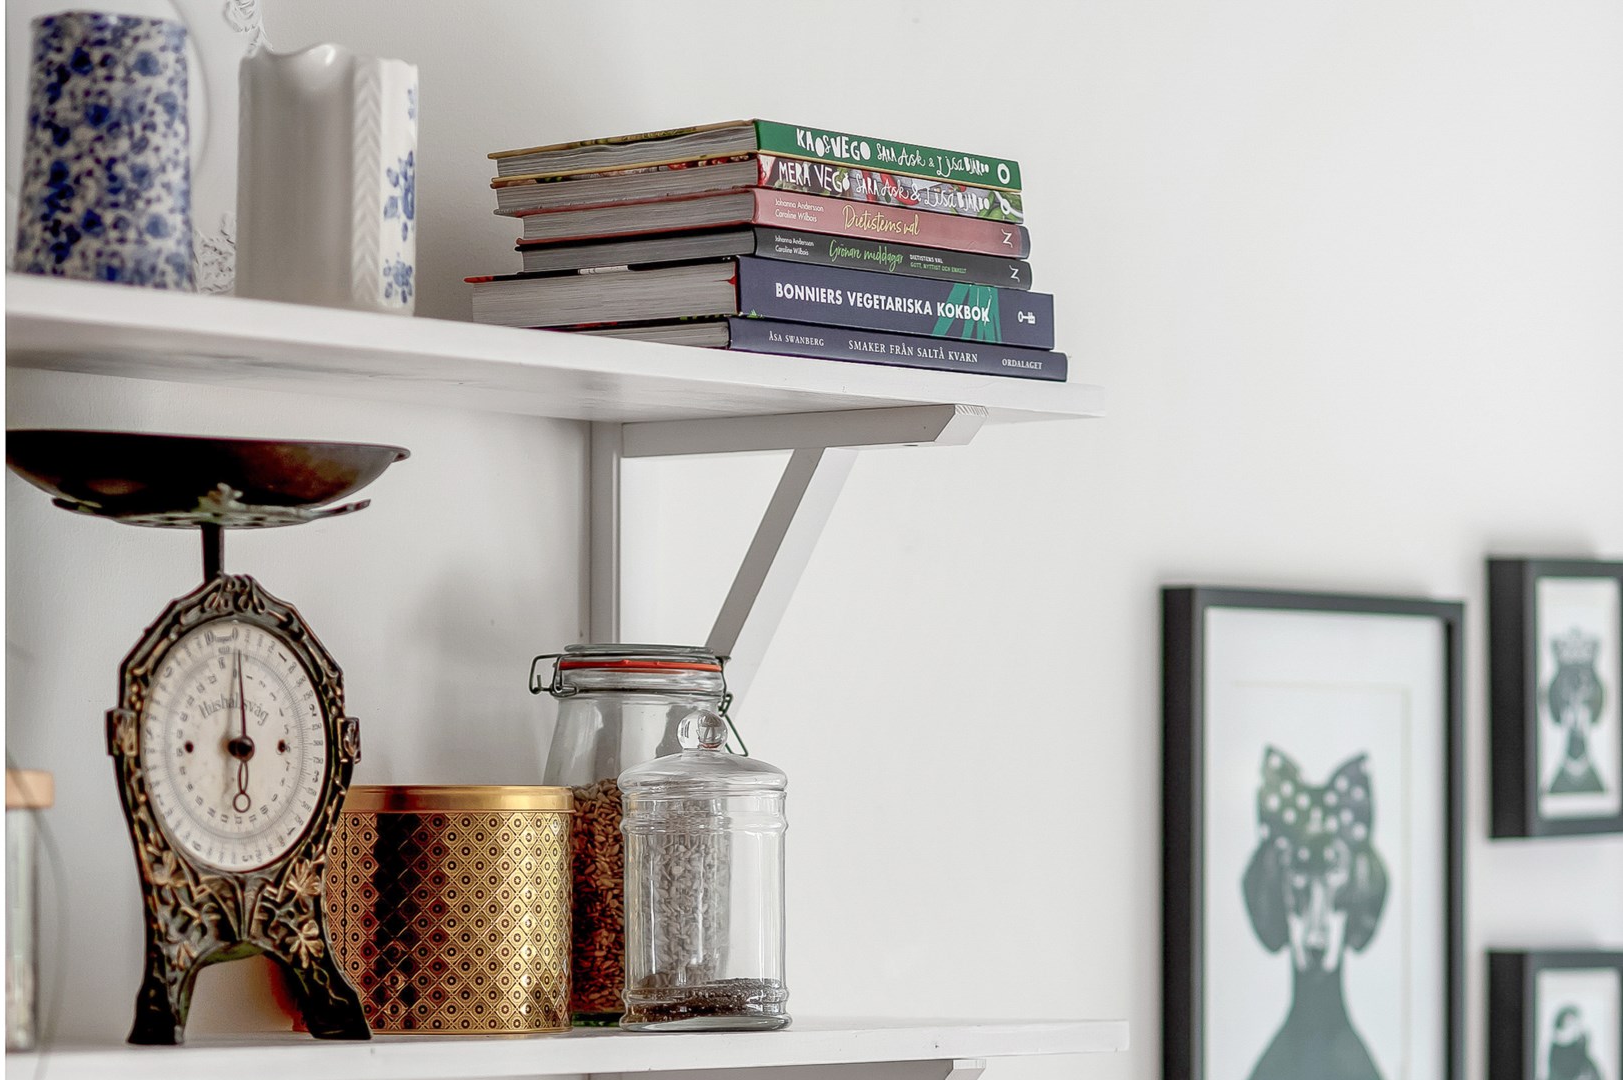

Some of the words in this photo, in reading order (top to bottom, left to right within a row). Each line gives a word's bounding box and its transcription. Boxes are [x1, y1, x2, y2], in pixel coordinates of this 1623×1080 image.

[876, 142, 897, 162] SARA
[897, 147, 926, 167] Ask
[928, 157, 935, 168] &
[936, 155, 965, 178] Lisa
[778, 161, 810, 187] MERA
[813, 164, 850, 192] VEGO
[855, 173, 880, 197] SARA
[880, 179, 909, 199] Ask
[910, 184, 921, 203] &
[924, 186, 957, 208] Lisa
[775, 197, 797, 208] Johanna
[797, 201, 825, 212] Andersson
[775, 208, 797, 219] Caroline
[903, 214, 921, 235] val
[829, 239, 862, 262] Grönare
[863, 244, 904, 272] middagar
[775, 282, 843, 305] BONNIERS
[847, 291, 932, 316] VEGETARISKA
[937, 302, 991, 324] KOKBOK
[768, 331, 784, 343] ÅSA
[785, 335, 825, 347] SWANBERG
[848, 340, 887, 353] SMAKER
[889, 341, 914, 356] FRÅN
[917, 347, 945, 360] SALTÅ
[948, 351, 978, 363] KVARN
[1002, 358, 1043, 371] ORDALAGET
[309, 703, 317, 717] 2
[312, 770, 320, 783] 3
